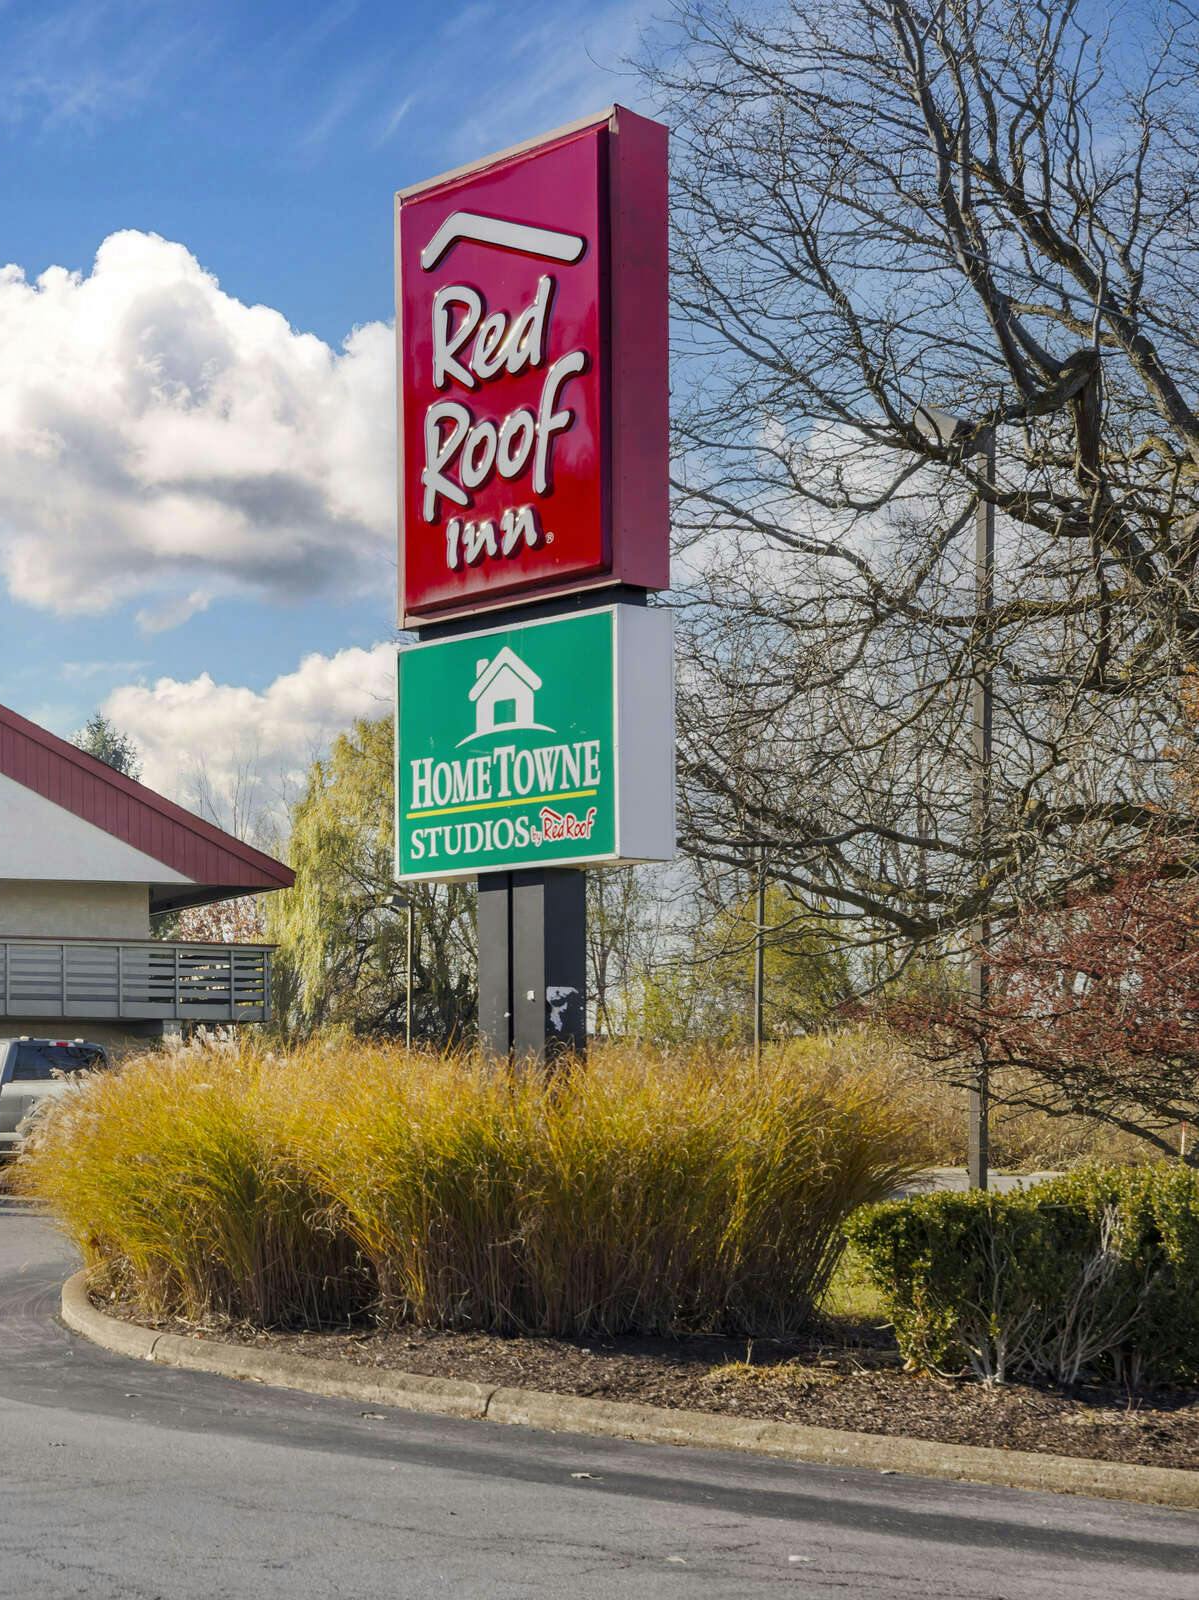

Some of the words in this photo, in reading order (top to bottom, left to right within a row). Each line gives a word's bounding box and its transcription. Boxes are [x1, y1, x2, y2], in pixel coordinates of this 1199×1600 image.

[433, 274, 552, 390] Red
[422, 351, 586, 523] Roof
[410, 816, 529, 859] STUDIOS
[530, 825, 542, 847] by
[543, 815, 565, 841] Red
[565, 807, 597, 839] Roof
